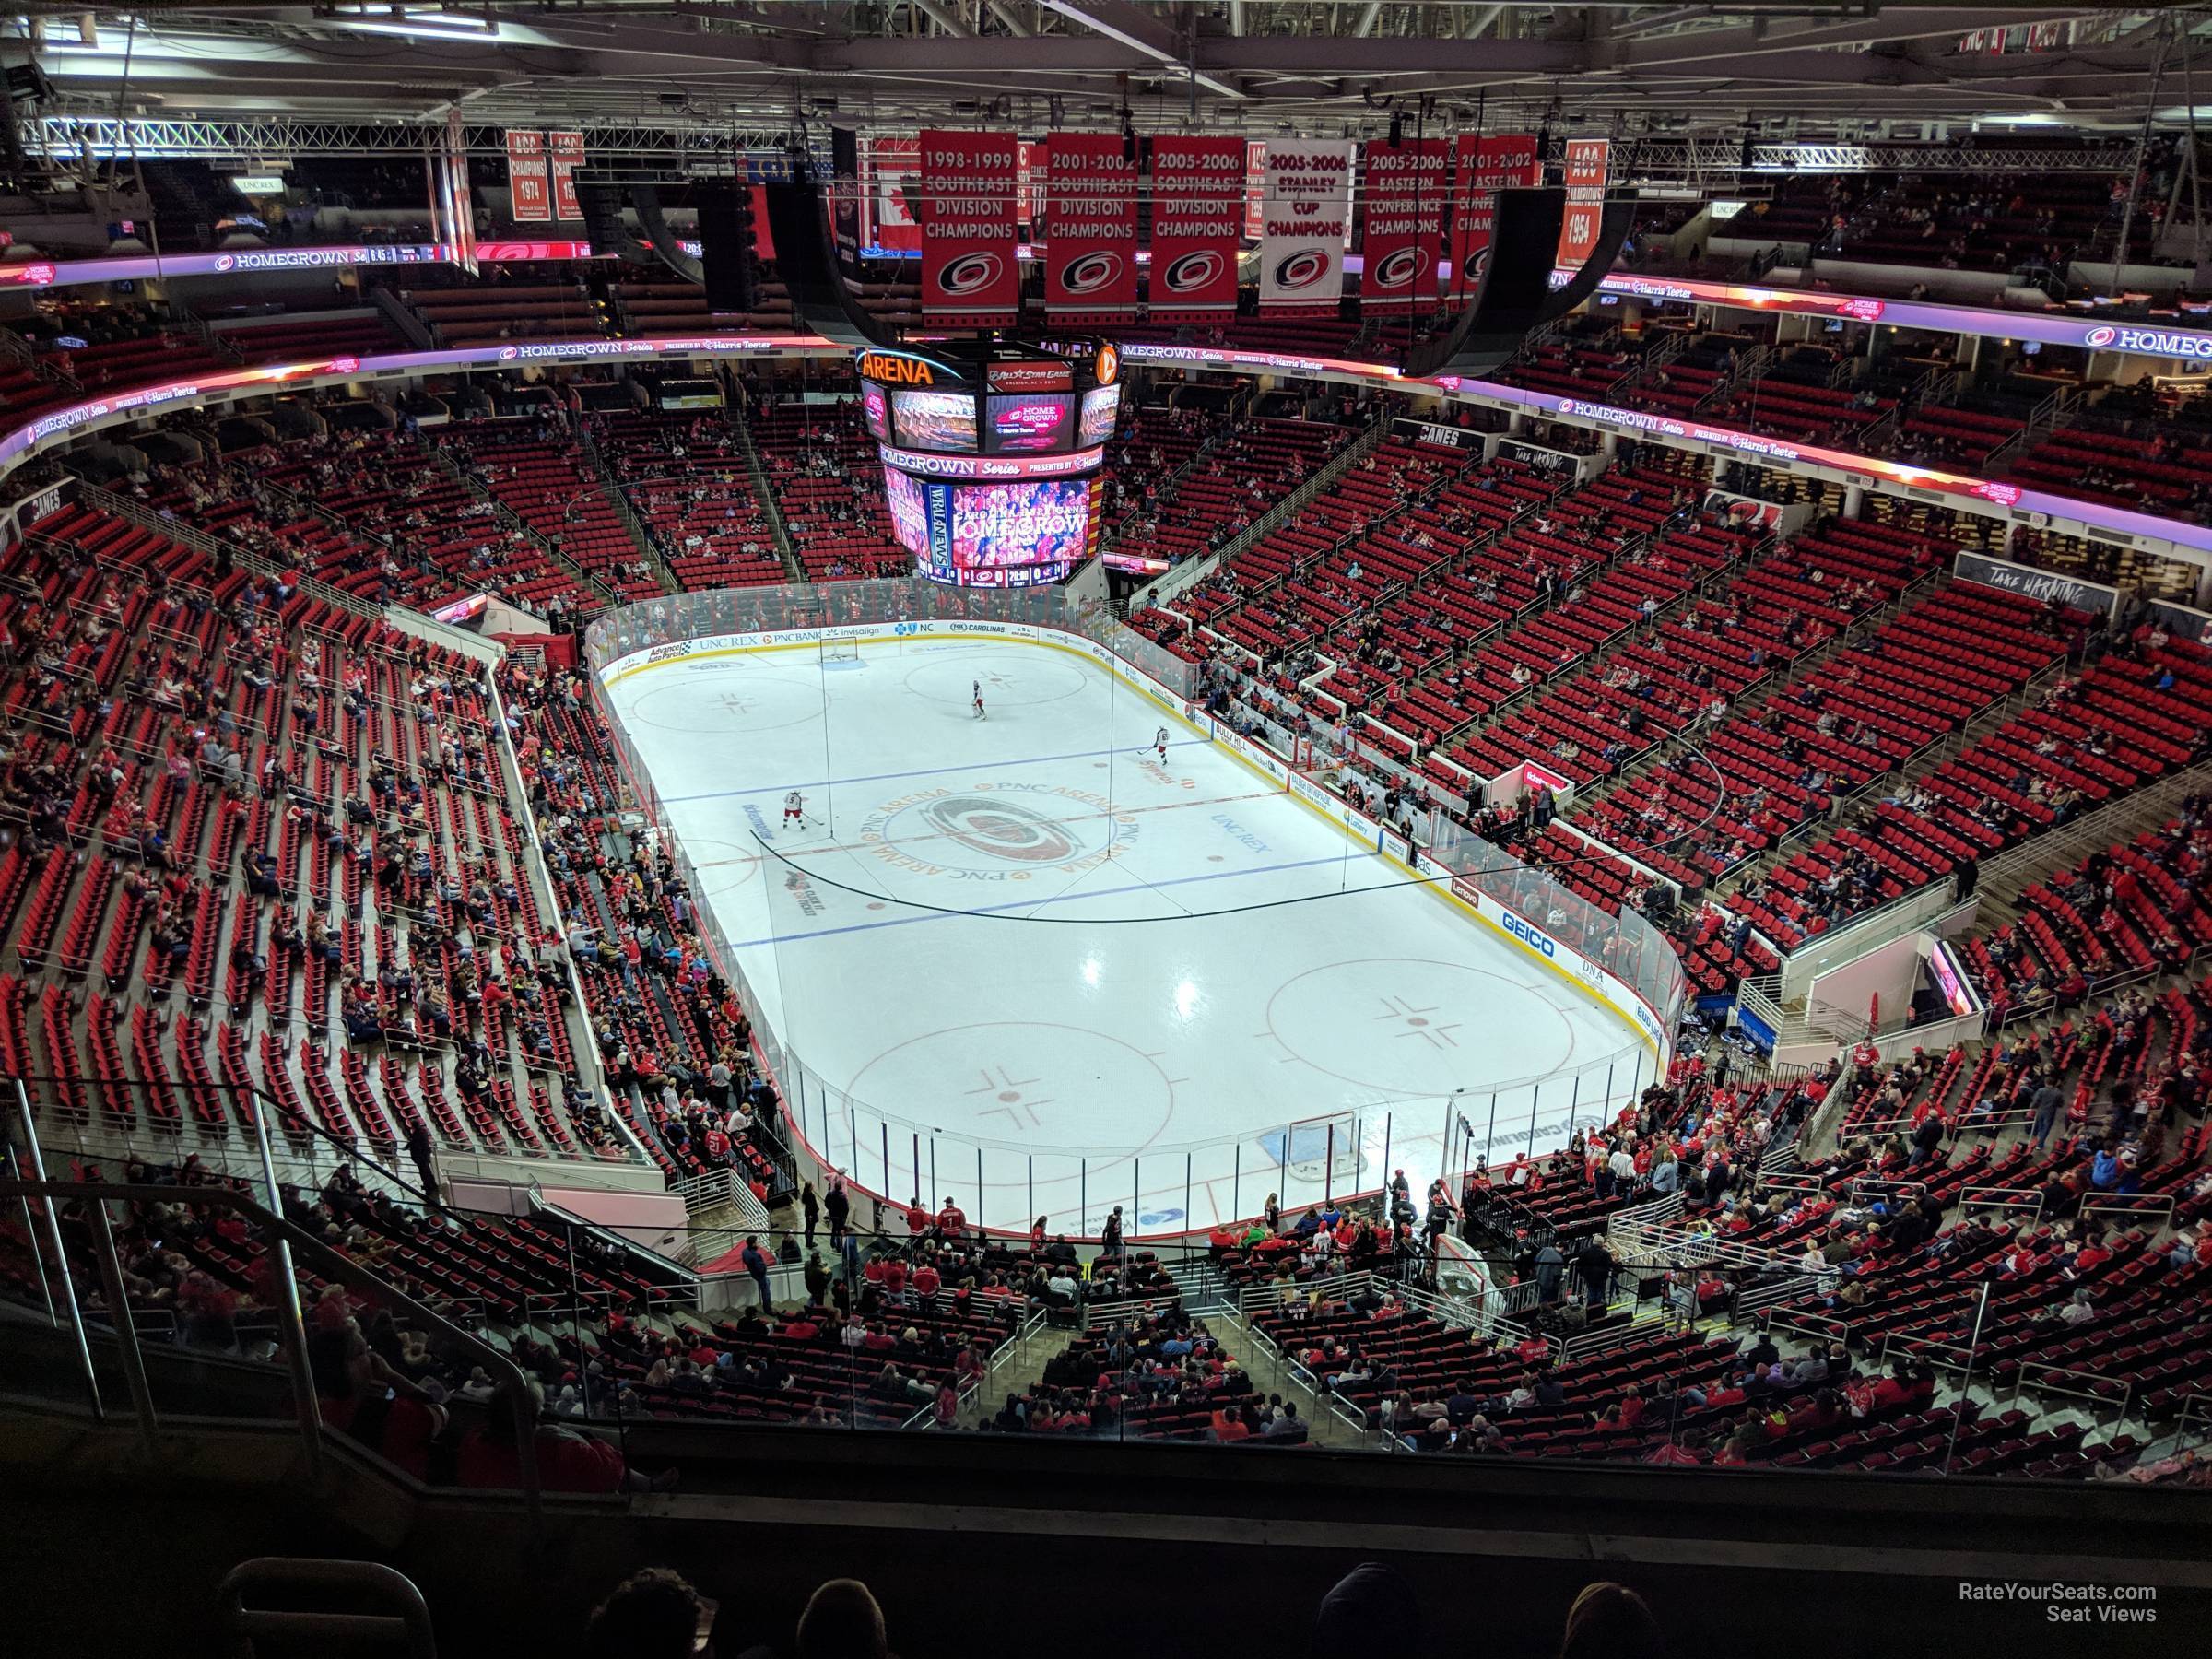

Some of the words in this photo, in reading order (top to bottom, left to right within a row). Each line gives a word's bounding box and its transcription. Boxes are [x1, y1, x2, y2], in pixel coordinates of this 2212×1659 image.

[926, 151, 1012, 169] 1998-1999
[1158, 153, 1239, 171] 2005-2006
[1269, 154, 1347, 171] 2005-2006
[1371, 156, 1444, 171] 2005-2006
[512, 161, 545, 177] CHAMPIONS
[521, 181, 539, 200] 1974
[926, 176, 1012, 193] SOUTHEAST
[1052, 177, 1135, 193] SOUTHEAST
[1157, 176, 1238, 192] SOUTHEAST
[1278, 177, 1337, 193] STANLEY
[935, 200, 1003, 216] DIVISION
[1061, 200, 1124, 216] DIVISION
[1165, 199, 1228, 215] DIVISION
[1292, 201, 1320, 215] CUP
[1370, 198, 1441, 214] CONFERNCE
[926, 223, 1013, 239] CHAMPIONS
[1051, 223, 1134, 239] CHAMPIONS
[1156, 221, 1236, 237] CHAMPIONS
[1267, 220, 1343, 237] CHAMPIONS
[1568, 214, 1590, 244] 1954
[237, 252, 350, 268] HOMEGROWN
[1641, 283, 1665, 296] Harris
[1665, 286, 1692, 299] Teeter
[520, 342, 622, 358] HOMEGROWN
[627, 342, 653, 352] Series
[713, 340, 741, 350] Harris
[743, 339, 771, 349] Teeter
[863, 349, 934, 384] ARENA
[1201, 350, 1224, 361] Series
[1275, 358, 1299, 368] Harris
[1300, 359, 1323, 370] Teeter
[1047, 371, 1071, 379] GAME
[34, 407, 90, 439] HOMEGROWN
[152, 389, 172, 404] Harris
[173, 385, 197, 398] Teeter
[1420, 426, 1459, 446] CANES
[1574, 402, 1659, 430] HOMEGROWN
[1660, 420, 1685, 436] Series
[1694, 429, 1721, 441] PRESENTED
[1740, 438, 1768, 453] Harris
[1770, 443, 1799, 459] Teeter
[982, 463, 1020, 475] Series
[1030, 463, 1060, 472] PRESENTED
[1062, 462, 1072, 471] BY
[32, 488, 61, 521] CANES
[1009, 570, 1030, 581] 20:00
[1990, 566, 2019, 587] TAKE
[2024, 572, 2086, 604] WARNING
[841, 627, 879, 637] invisalign
[920, 623, 934, 631] NC
[969, 624, 1005, 633] CAROLINAS
[700, 639, 729, 650] UNC
[731, 635, 758, 646] REX
[774, 633, 794, 642] PNC
[650, 644, 680, 656] Advance
[662, 651, 680, 661] Parts
[1216, 725, 1233, 743] BULLY
[1234, 737, 1247, 751] HILL
[997, 782, 1047, 792] PNC
[1053, 786, 1121, 812] ARENA
[860, 812, 889, 833] PNC
[877, 787, 952, 813] ARENA
[1211, 814, 1245, 834] UNC
[1240, 831, 1273, 853] REX
[1453, 881, 1477, 903] Lenovo
[1502, 912, 1555, 958] GEICO
[1583, 960, 1604, 982] DNA
[1637, 1006, 1652, 1030] BUD
